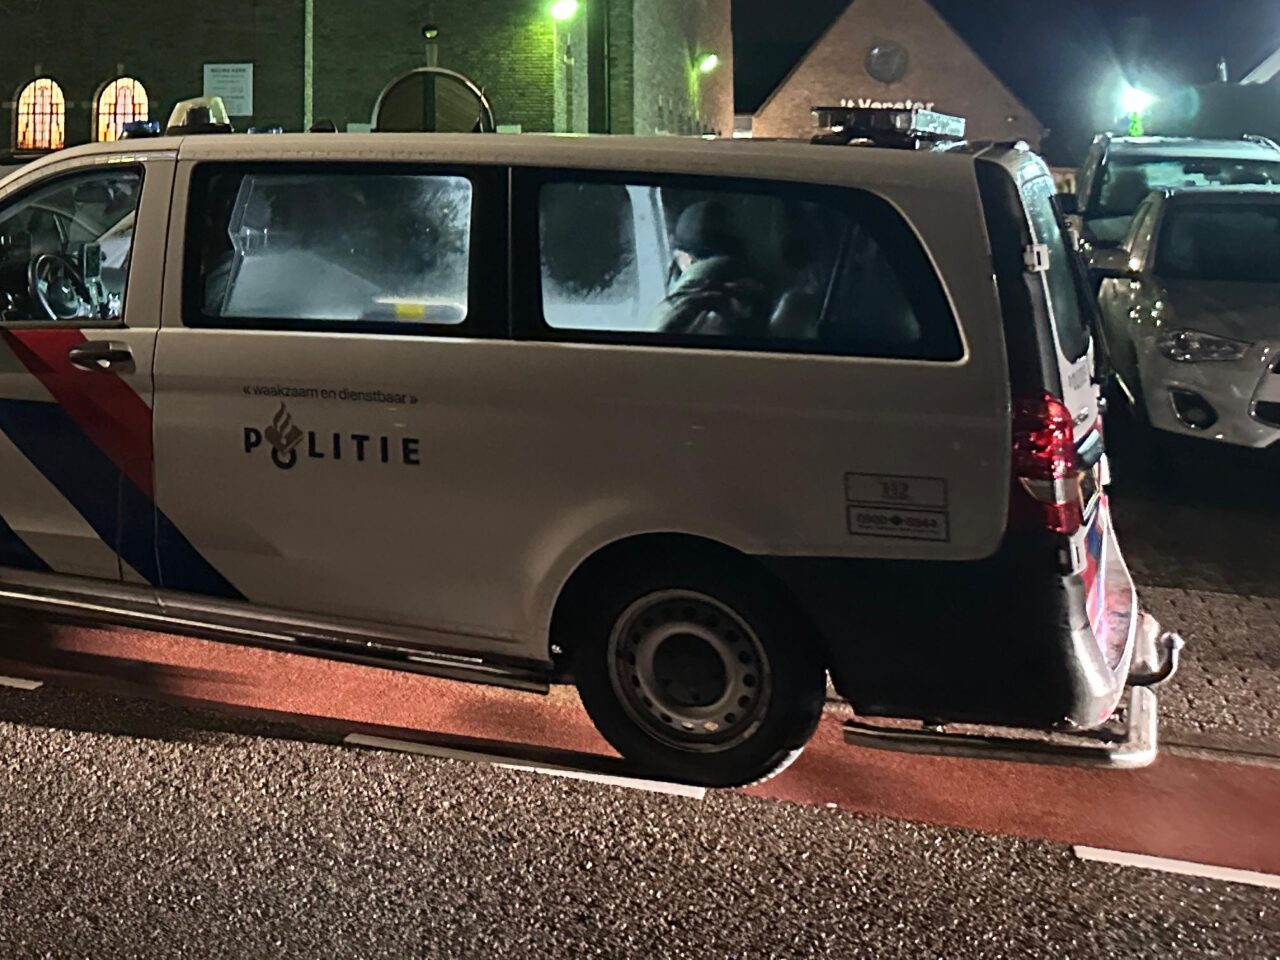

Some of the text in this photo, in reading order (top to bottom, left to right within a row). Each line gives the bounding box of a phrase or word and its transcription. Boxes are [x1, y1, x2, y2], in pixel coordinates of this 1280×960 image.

[253, 384, 319, 399] waakzaam
[321, 389, 337, 401] en
[339, 390, 408, 404] dienstbaar
[244, 427, 420, 470] POLITIE
